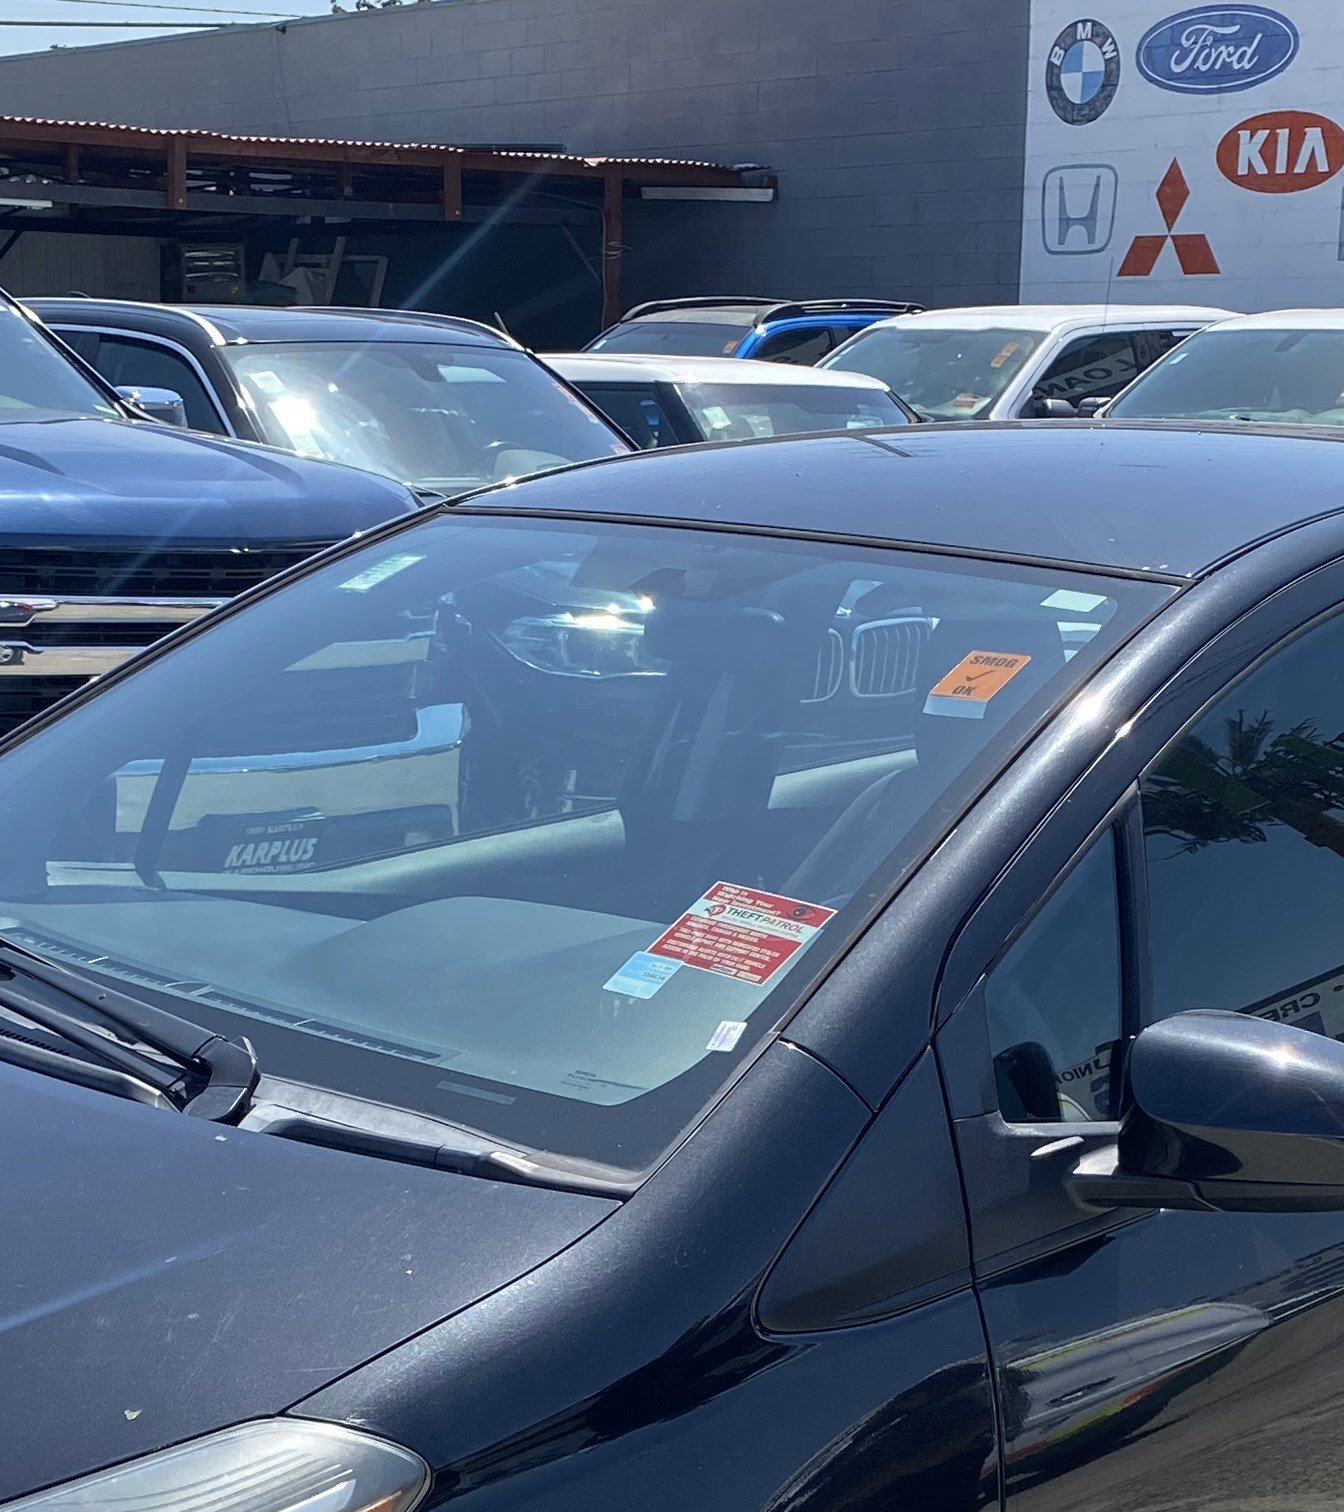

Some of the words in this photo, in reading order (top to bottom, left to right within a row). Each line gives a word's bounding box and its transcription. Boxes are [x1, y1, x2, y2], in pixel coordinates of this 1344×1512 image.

[1050, 21, 1118, 66] BMW
[1169, 23, 1262, 73] Ford
[1236, 125, 1330, 177] KIA
[969, 655, 1018, 668] SMOG
[951, 684, 978, 696] OK
[223, 838, 318, 869] KARPLUS
